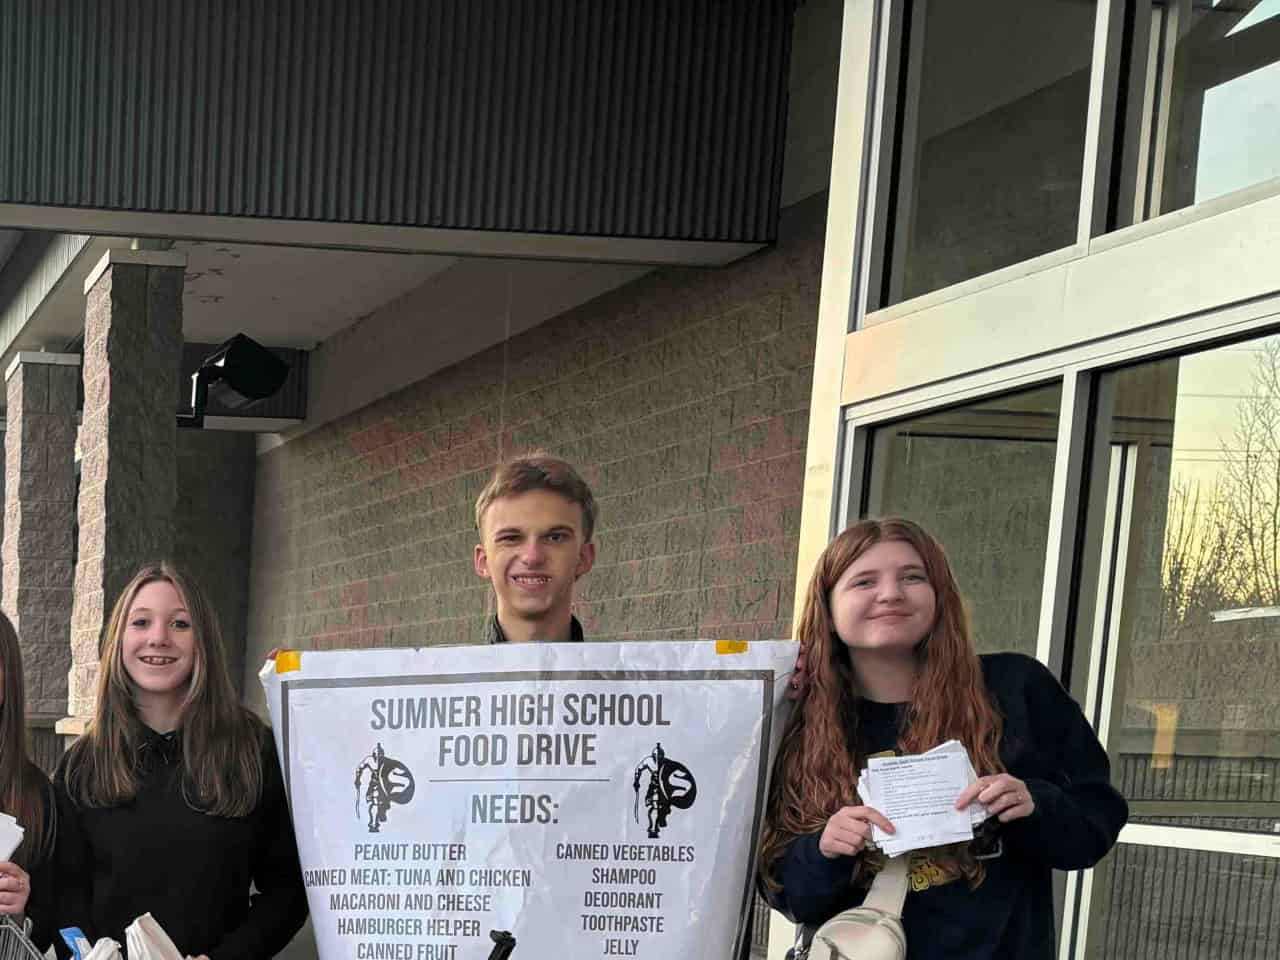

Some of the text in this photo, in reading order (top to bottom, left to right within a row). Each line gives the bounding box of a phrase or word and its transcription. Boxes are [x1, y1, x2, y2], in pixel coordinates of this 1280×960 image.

[370, 693, 671, 730] SUMNER HIGH SCHOOL
[438, 733, 597, 767] FOOD DRIVE
[471, 794, 559, 825] NEEDS:
[354, 843, 467, 861] PEANUT BUTTER
[556, 843, 695, 862] CANNED VEGETABLES
[304, 868, 531, 887] CANNED MEAT: TUNA AND CHICKEN
[592, 867, 656, 885] SHAMPOO
[330, 894, 491, 912] MACARONI AND CHEESE
[584, 891, 663, 909] DEODORANT
[338, 918, 481, 937] HAMBURGER HELPER
[581, 914, 664, 932] TOOTHPASTE
[357, 943, 413, 960] CANNED
[603, 939, 640, 955] JELLY
